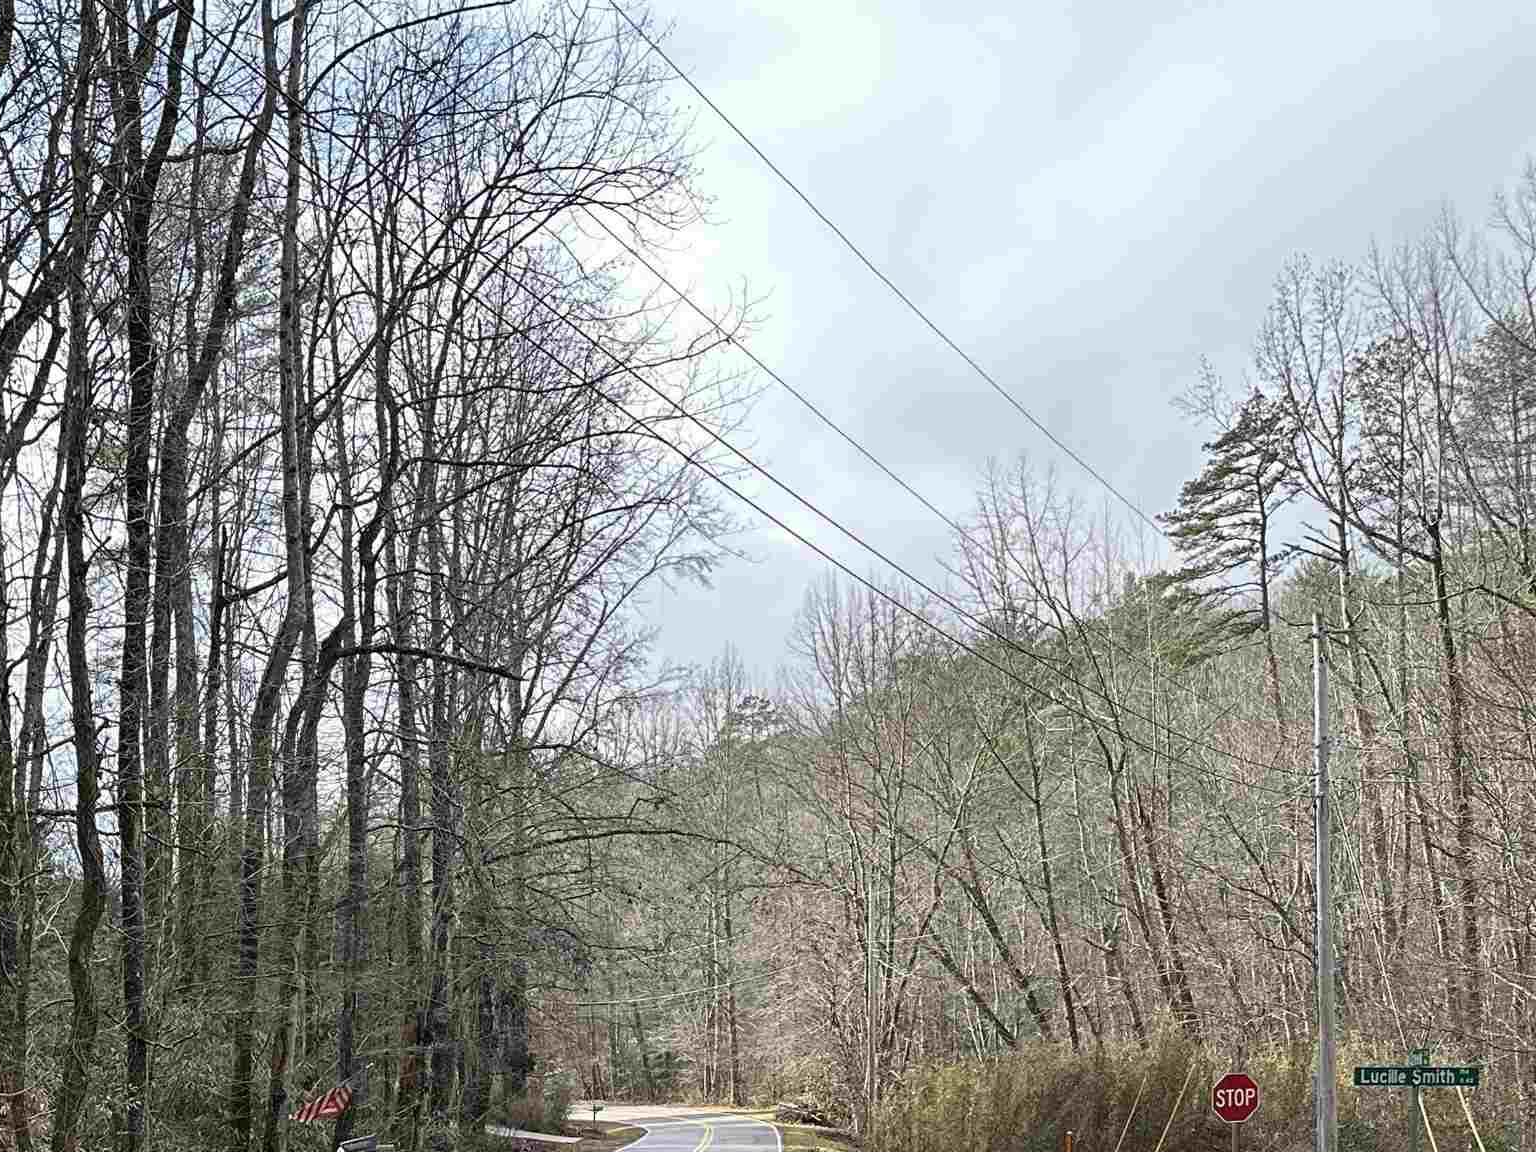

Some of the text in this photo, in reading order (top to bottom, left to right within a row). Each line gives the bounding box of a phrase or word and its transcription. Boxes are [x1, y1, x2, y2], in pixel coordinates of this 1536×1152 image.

[1360, 1069, 1407, 1084] Lucille
[1412, 1069, 1456, 1085] Smith
[1216, 1088, 1256, 1108] STOP
